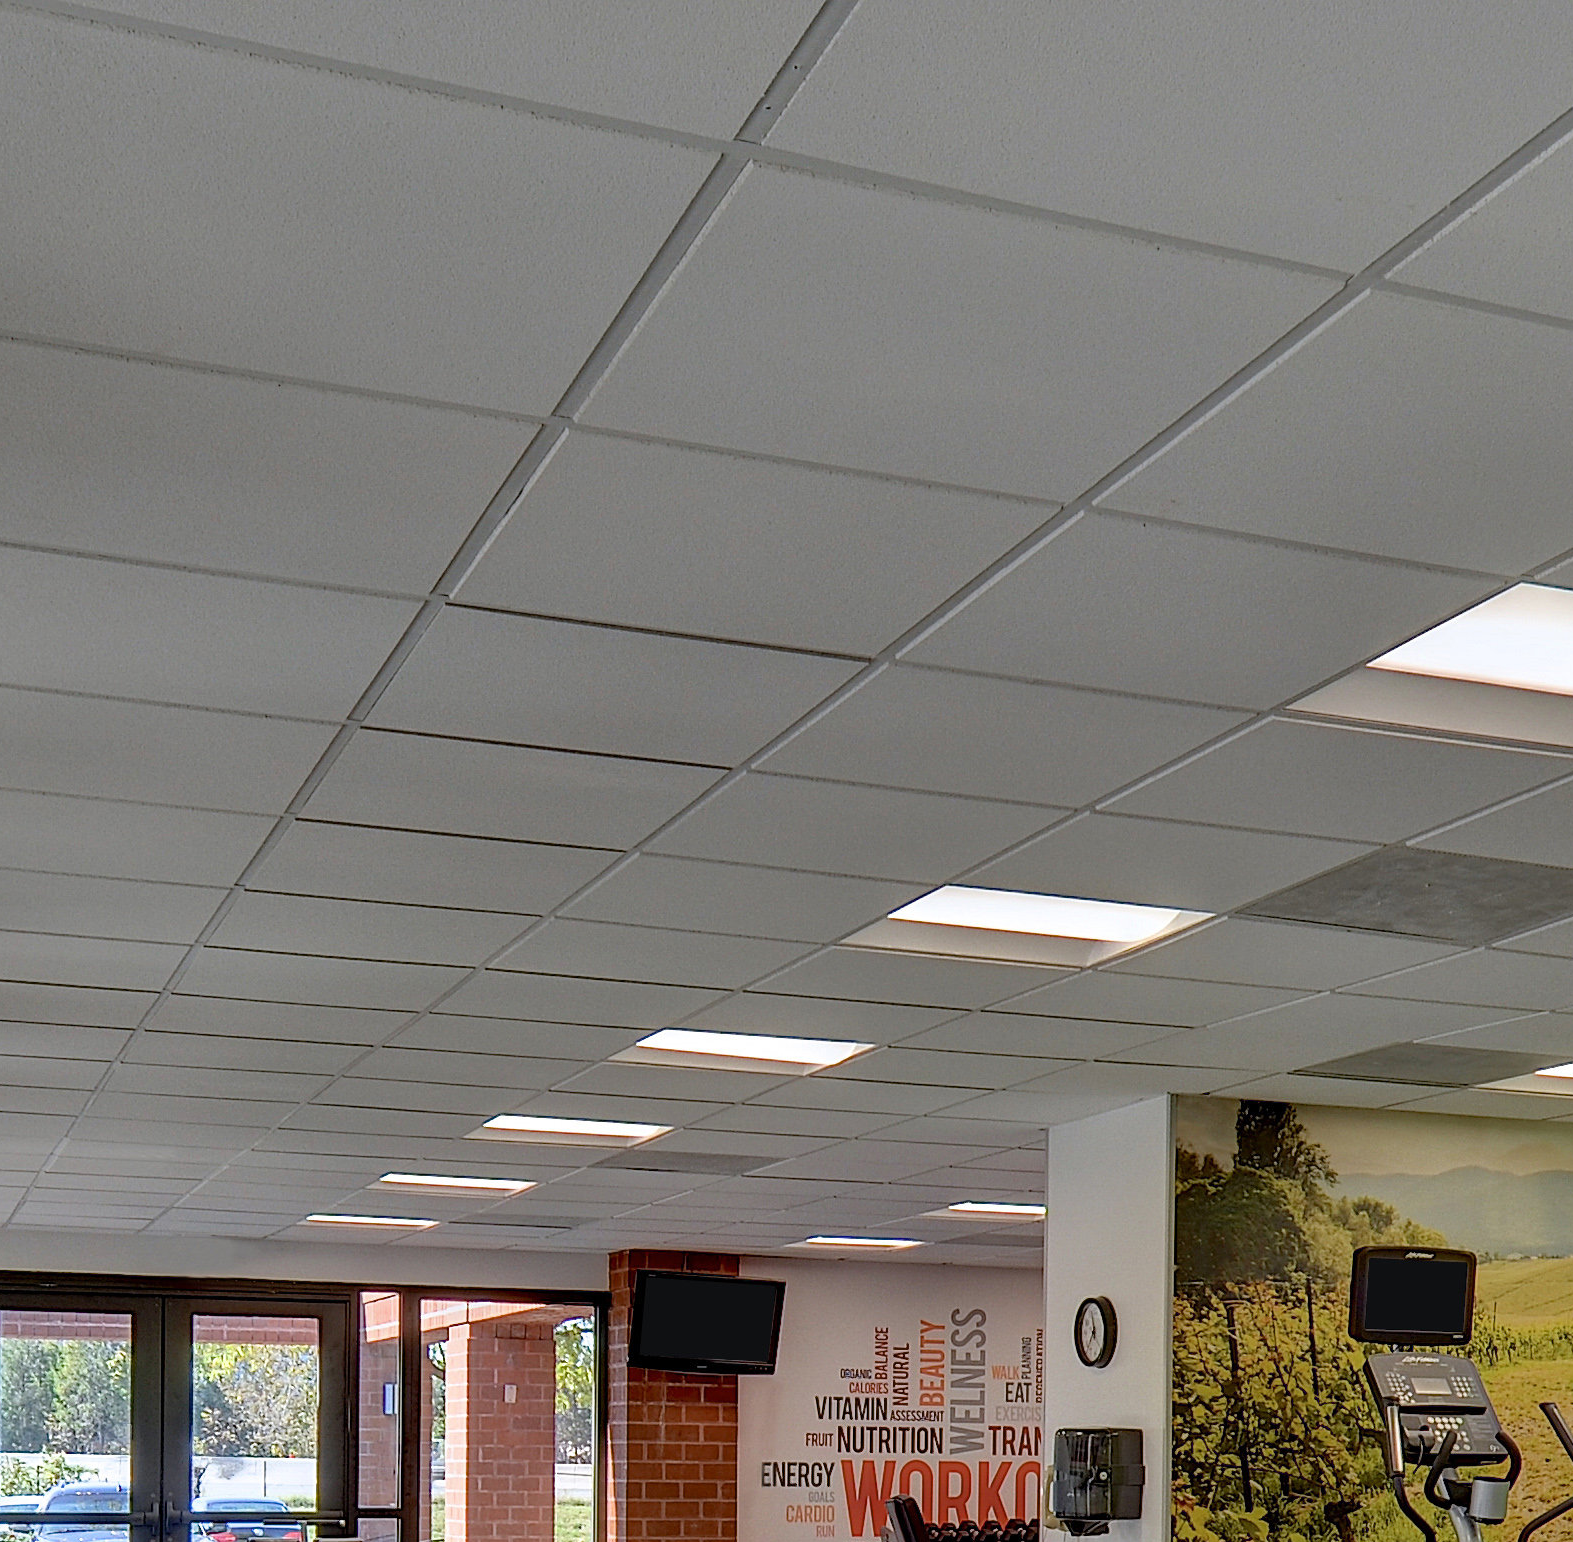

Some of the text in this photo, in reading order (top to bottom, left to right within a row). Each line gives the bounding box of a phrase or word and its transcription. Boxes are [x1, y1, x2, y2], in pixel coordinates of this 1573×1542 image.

[874, 1326, 889, 1379] BALANCE
[920, 1319, 945, 1406] BEAUTY
[892, 1342, 910, 1406] NATURAL
[950, 1308, 986, 1455] WELNESS
[992, 1365, 1020, 1380] WALK
[849, 1382, 889, 1394] CALORIES
[1005, 1382, 1032, 1403] EAT
[815, 1396, 888, 1420] VITAMIN
[890, 1410, 944, 1422] ASSESSMENT
[805, 1433, 834, 1447] FRUIT
[837, 1426, 944, 1454] NUTRITION
[761, 1461, 835, 1488] ENERGY
[808, 1492, 835, 1503] GOALS
[786, 1505, 835, 1523] CARDIO
[816, 1525, 835, 1537] RUN
